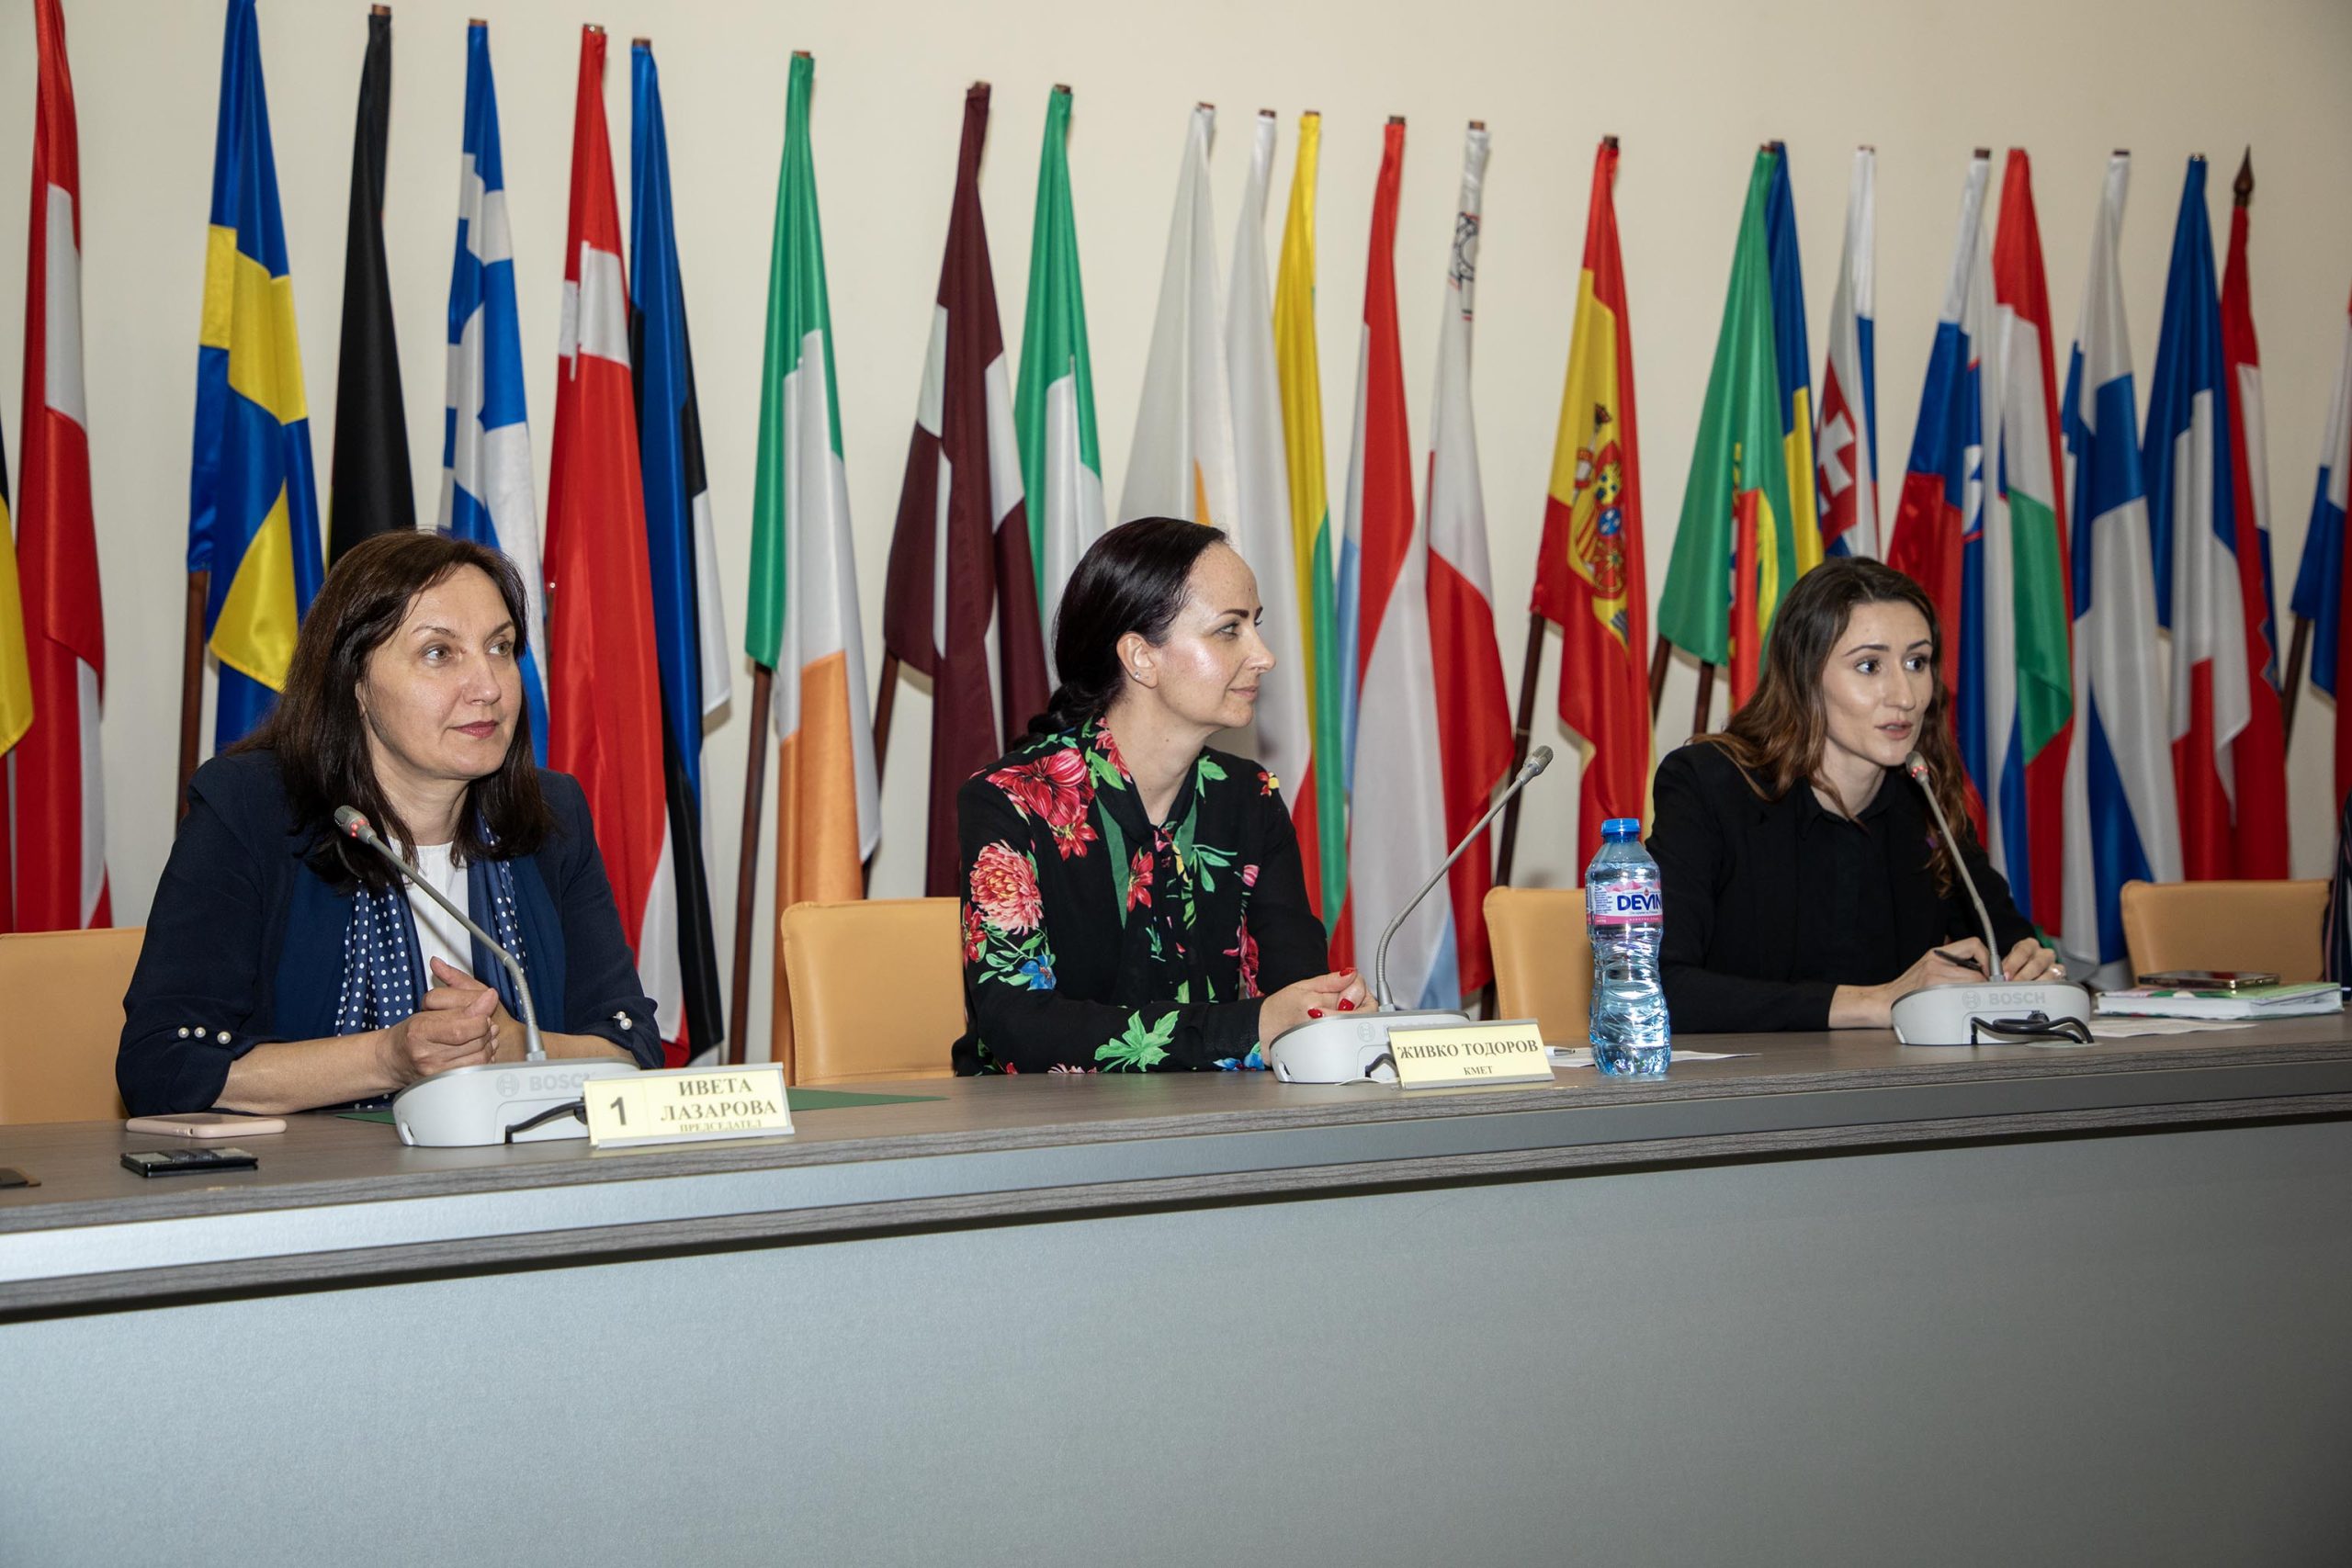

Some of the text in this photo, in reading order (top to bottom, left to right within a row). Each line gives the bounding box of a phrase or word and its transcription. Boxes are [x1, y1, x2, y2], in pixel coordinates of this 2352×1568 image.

[1616, 894, 1661, 911] DEVIN
[1988, 991, 2046, 1005] BOSCH
[1397, 1039, 1539, 1059] ЖИВКО ТОДОРОВ
[1464, 1066, 1493, 1076] КМЕТ
[678, 1077, 753, 1097] ИВЕТА
[610, 1096, 627, 1126] 1
[661, 1100, 778, 1122] ЛАЗАРОВА
